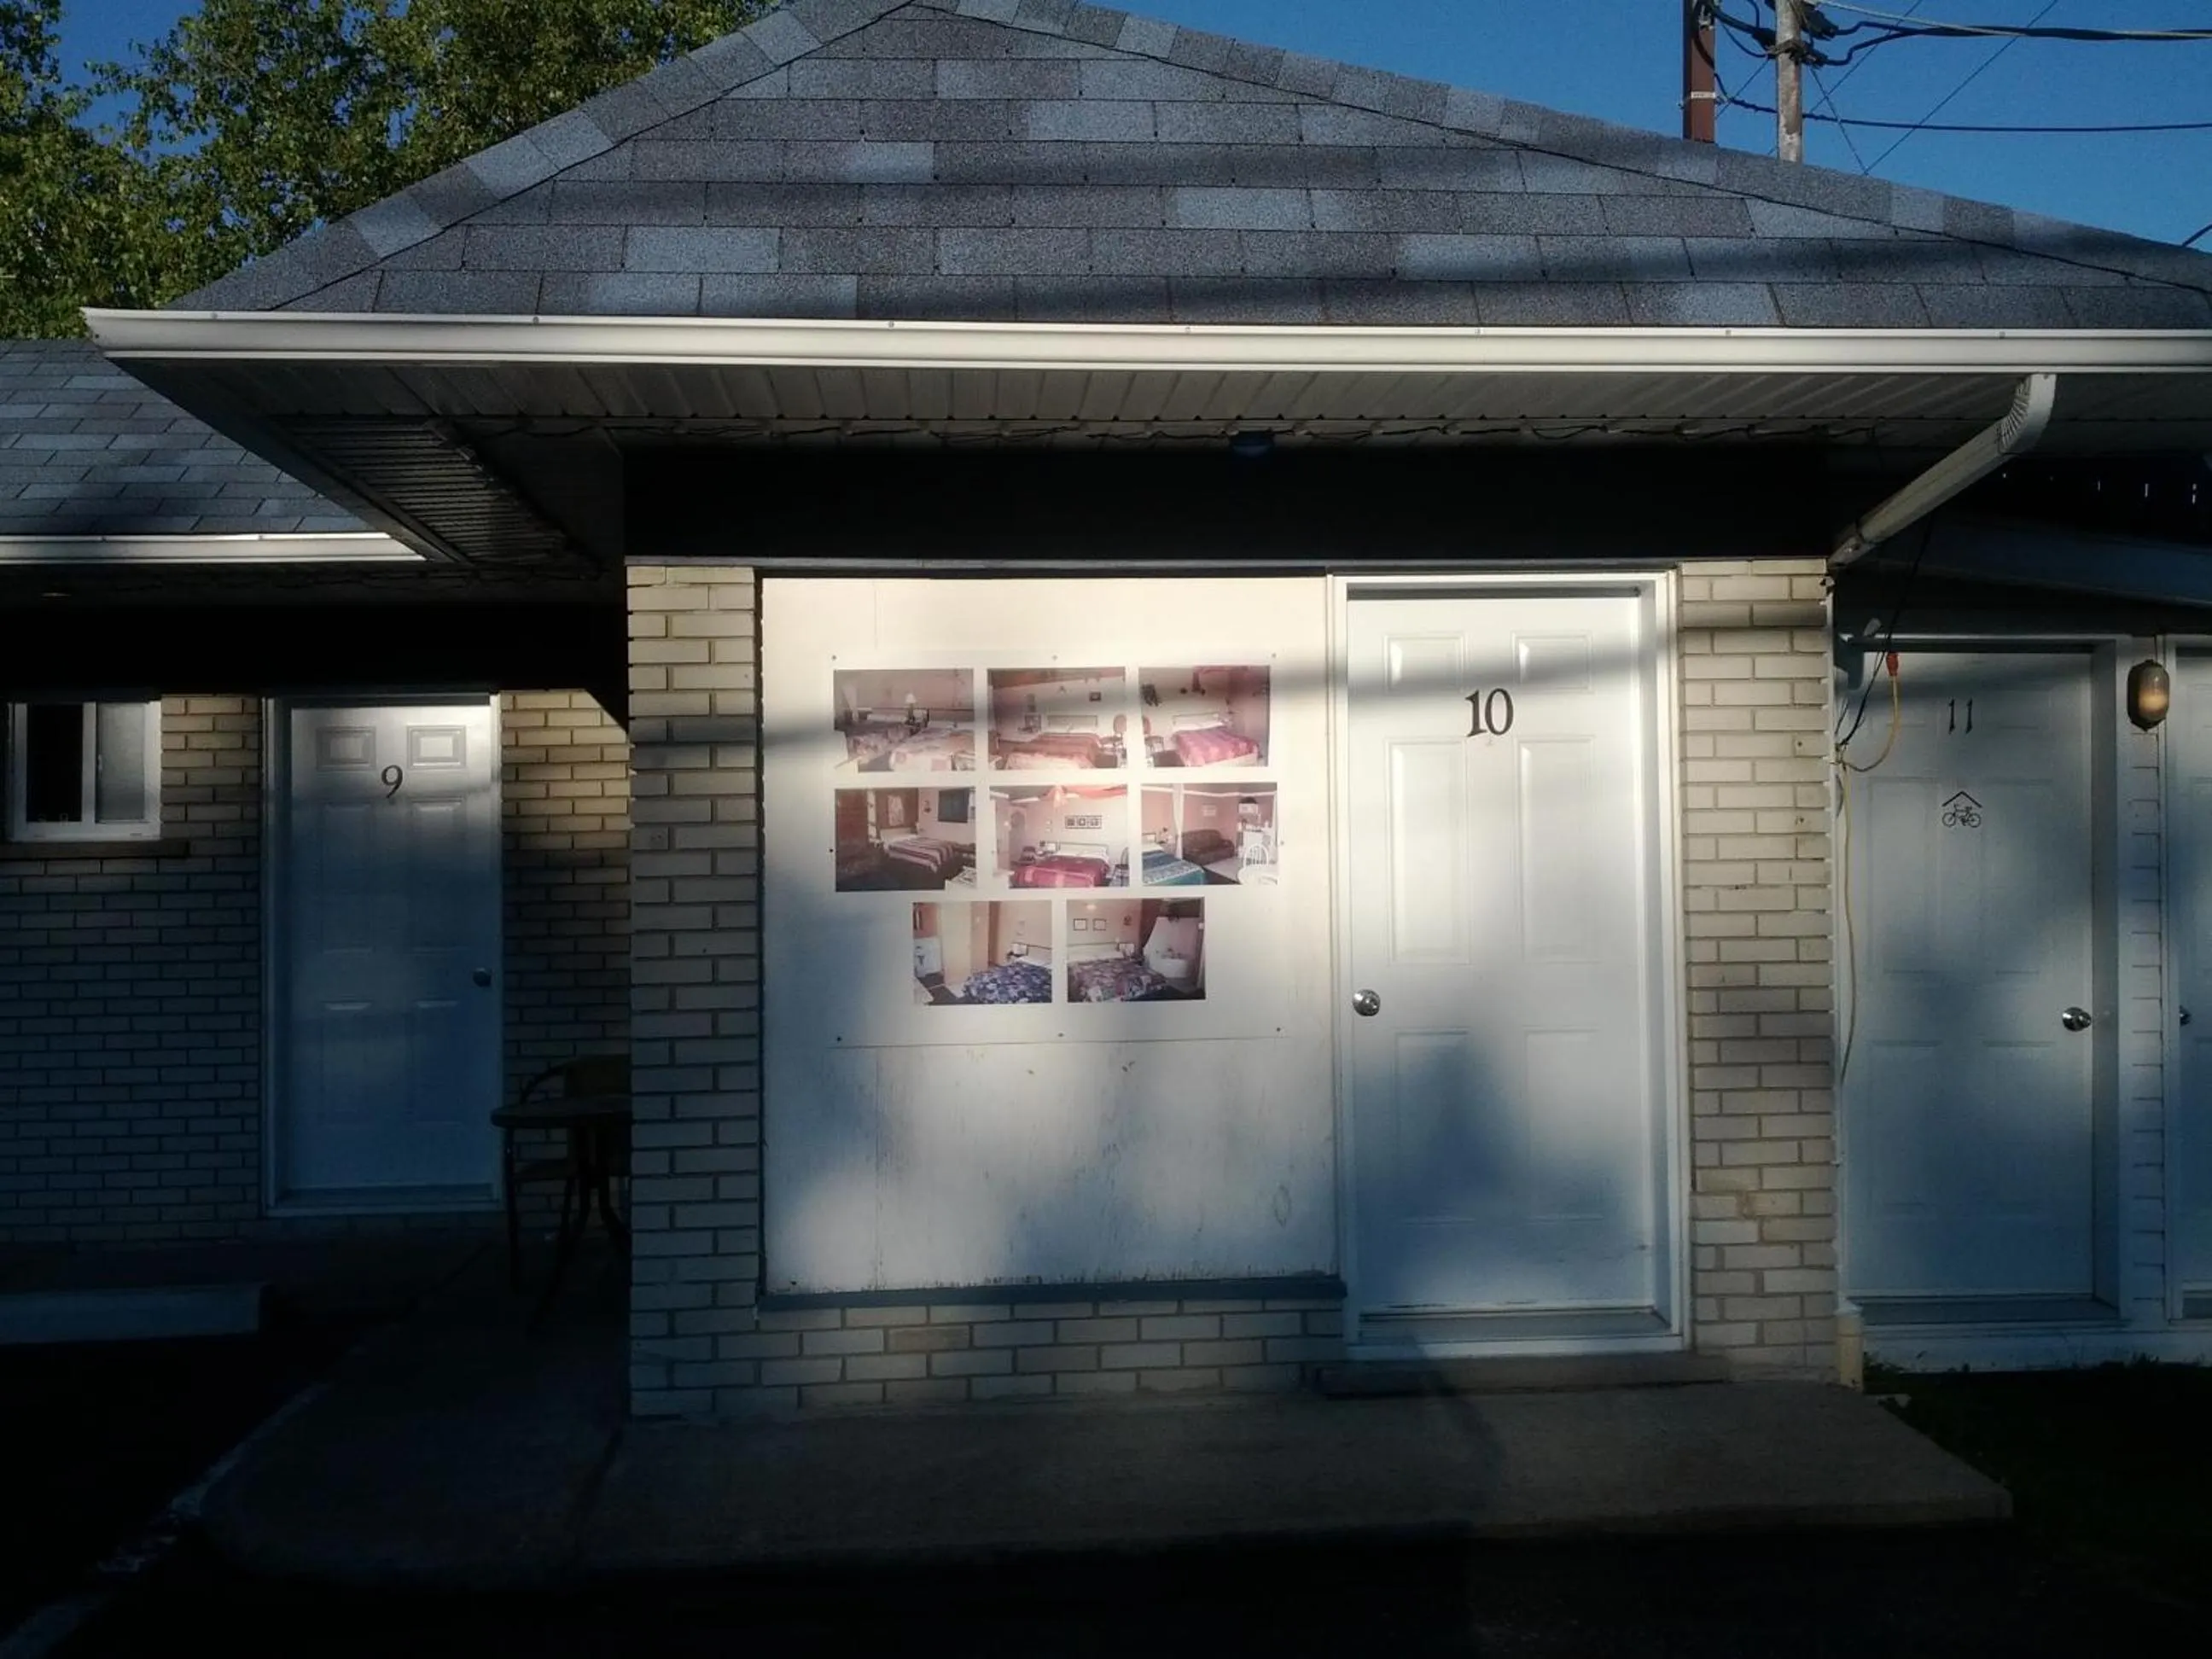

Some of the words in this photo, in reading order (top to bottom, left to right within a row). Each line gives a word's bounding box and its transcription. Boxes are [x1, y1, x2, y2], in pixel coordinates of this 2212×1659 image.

[1464, 688, 1514, 737] 10
[1948, 698, 1973, 735] 11
[381, 765, 403, 799] 9
